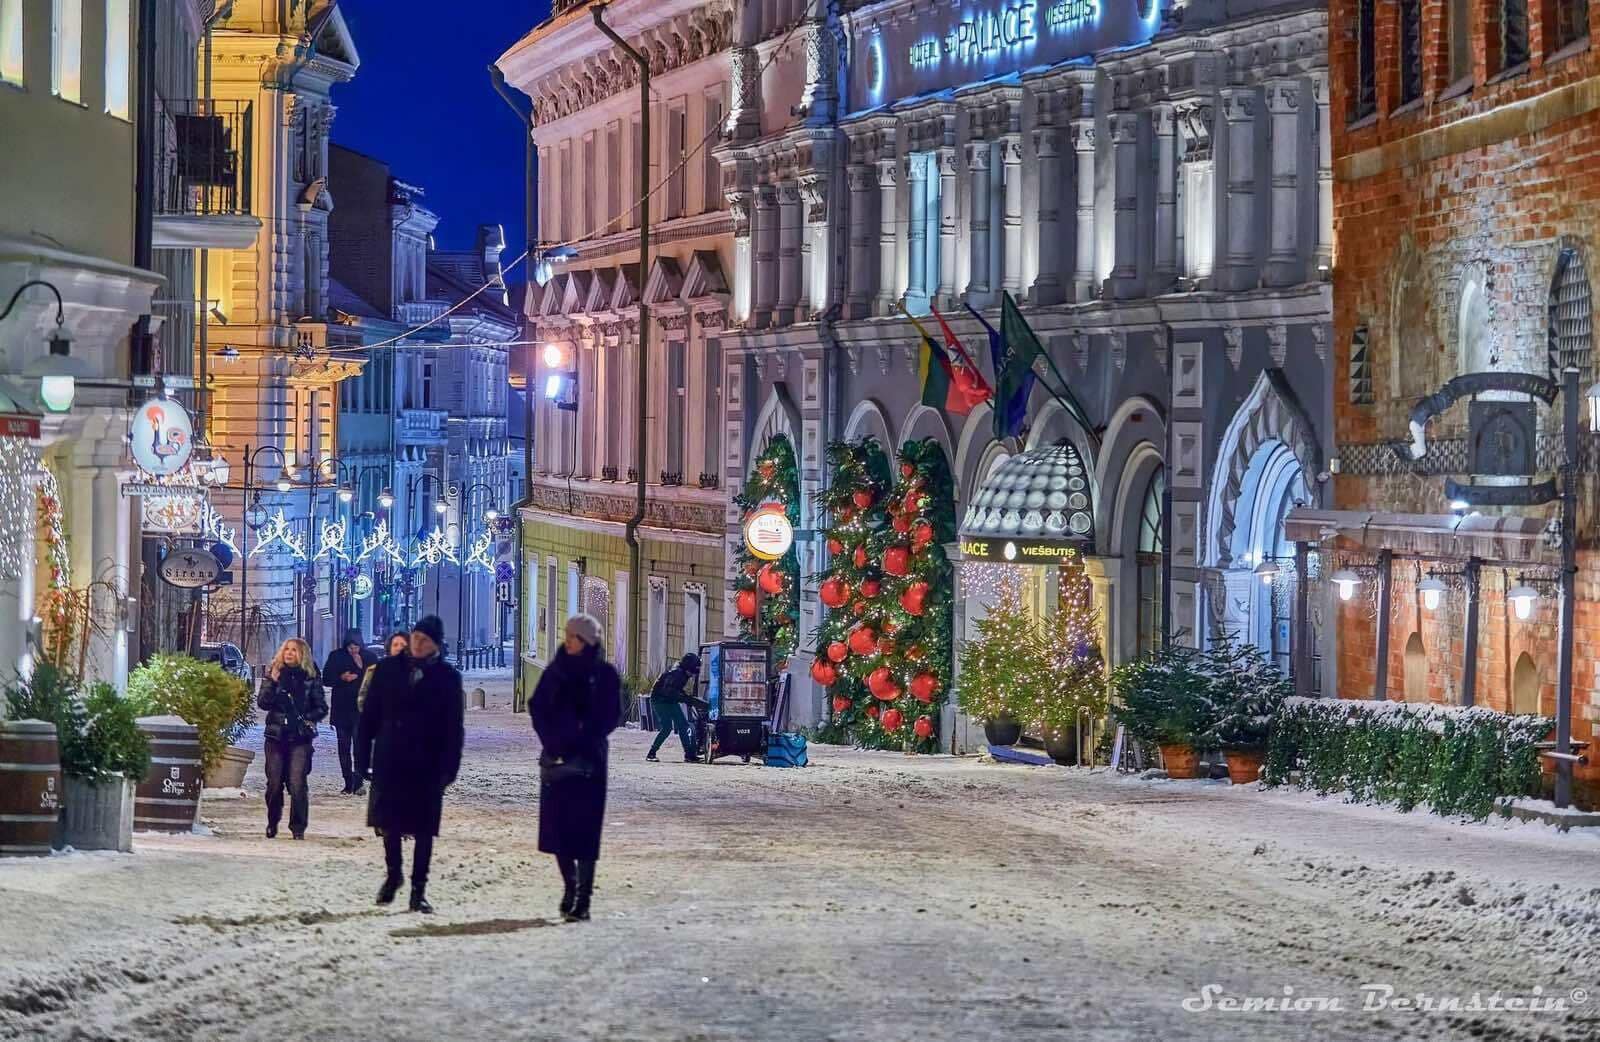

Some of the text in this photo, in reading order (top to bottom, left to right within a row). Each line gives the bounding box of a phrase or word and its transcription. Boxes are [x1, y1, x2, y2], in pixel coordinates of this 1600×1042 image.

[957, 3, 1035, 57] PALACE
[1021, 545, 1076, 556] VIEŠBUTIS
[165, 568, 214, 577] Sirena
